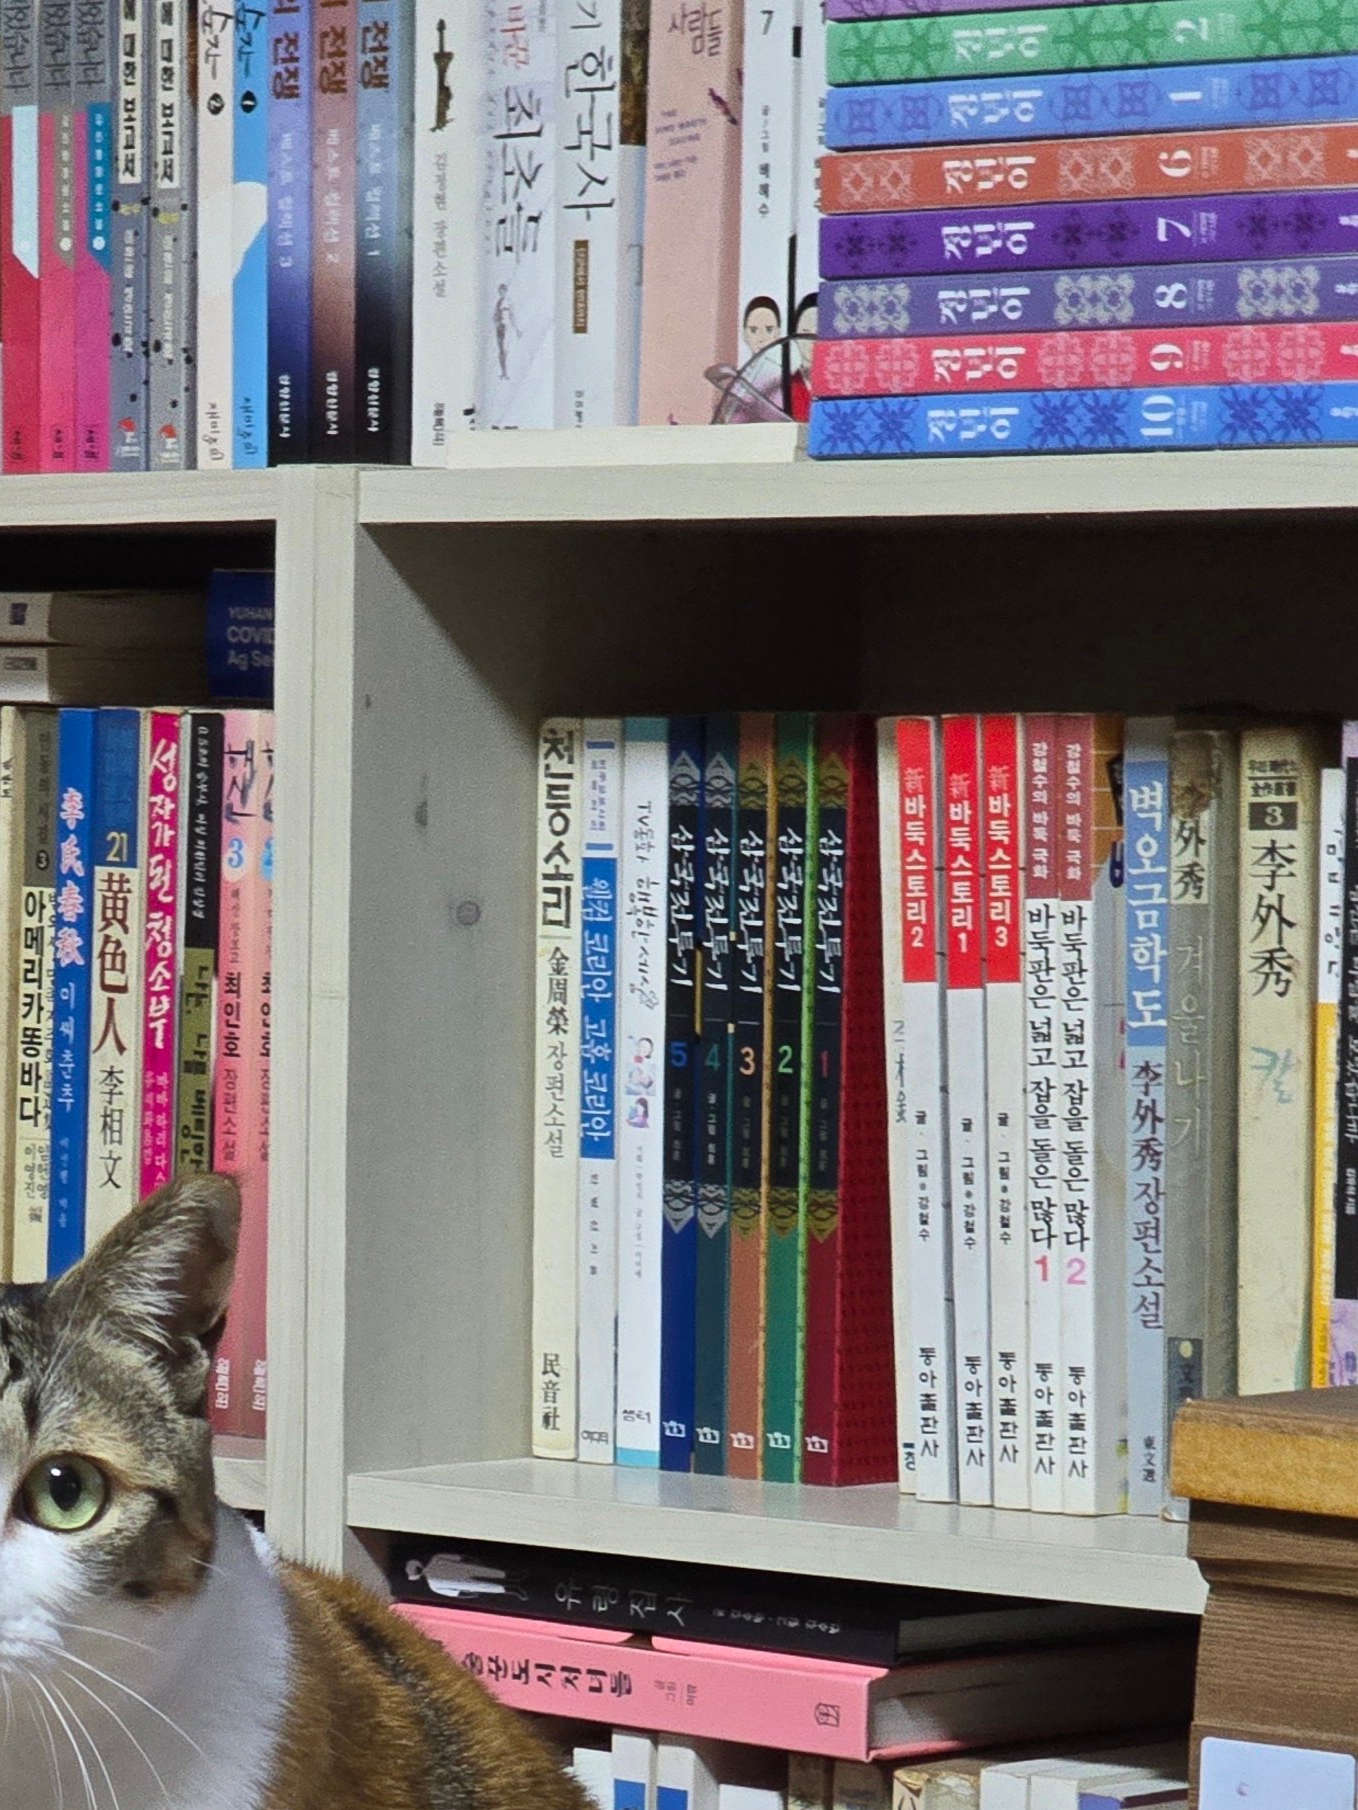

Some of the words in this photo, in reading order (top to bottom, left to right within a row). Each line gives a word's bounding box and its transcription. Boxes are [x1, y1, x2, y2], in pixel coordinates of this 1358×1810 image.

[760, 10, 774, 36] 7
[1173, 17, 1209, 43] 2
[563, 46, 617, 222] 한국사
[1169, 91, 1203, 102] 1
[493, 85, 543, 256] 최초들
[1158, 149, 1193, 177] 6
[1157, 217, 1192, 243] 7
[1154, 282, 1189, 310] 8
[1149, 343, 1184, 371] 9
[1140, 395, 1175, 438] 10
[105, 831, 128, 864] 21
[147, 739, 179, 849] 성자가
[541, 728, 575, 929] 천둥소리
[1031, 811, 1049, 844] 바둑
[1065, 812, 1083, 846] 바둑
[147, 856, 176, 905] 된
[670, 824, 695, 987] 삼국전투기
[703, 828, 730, 992] 삼국전투기
[737, 830, 765, 995] 삼국전투기
[775, 828, 804, 993] 삼국전투기
[817, 829, 844, 994] 삼국전투기
[1128, 779, 1169, 1030] 벽오금학도
[1247, 838, 1298, 999] 李外秀
[144, 913, 176, 1050] 청소부
[1027, 902, 1056, 1011] 바둑판은
[1060, 903, 1089, 1012] 바둑판은
[1028, 1016, 1056, 1068] 넓고
[1061, 1019, 1089, 1070] 넓고
[1173, 932, 1206, 1149] 겨울나기
[98, 1066, 125, 1190] 李相文
[544, 1041, 568, 1159] 장편소설
[1131, 1059, 1165, 1172] 李外秀
[1029, 1138, 1057, 1190] 돌은
[1061, 1140, 1090, 1192] 돌은
[1029, 1196, 1058, 1250] 많다
[1062, 1199, 1091, 1252] 많다
[1131, 1176, 1165, 1331] 장편소설
[541, 1353, 561, 1432] 民音社
[919, 1346, 940, 1459] 동아출판사
[964, 1355, 986, 1467] 동아출판사
[998, 1350, 1019, 1463] 동아출판사
[1033, 1362, 1055, 1476] 동아출판사
[1066, 1366, 1088, 1479] 동아출판사
